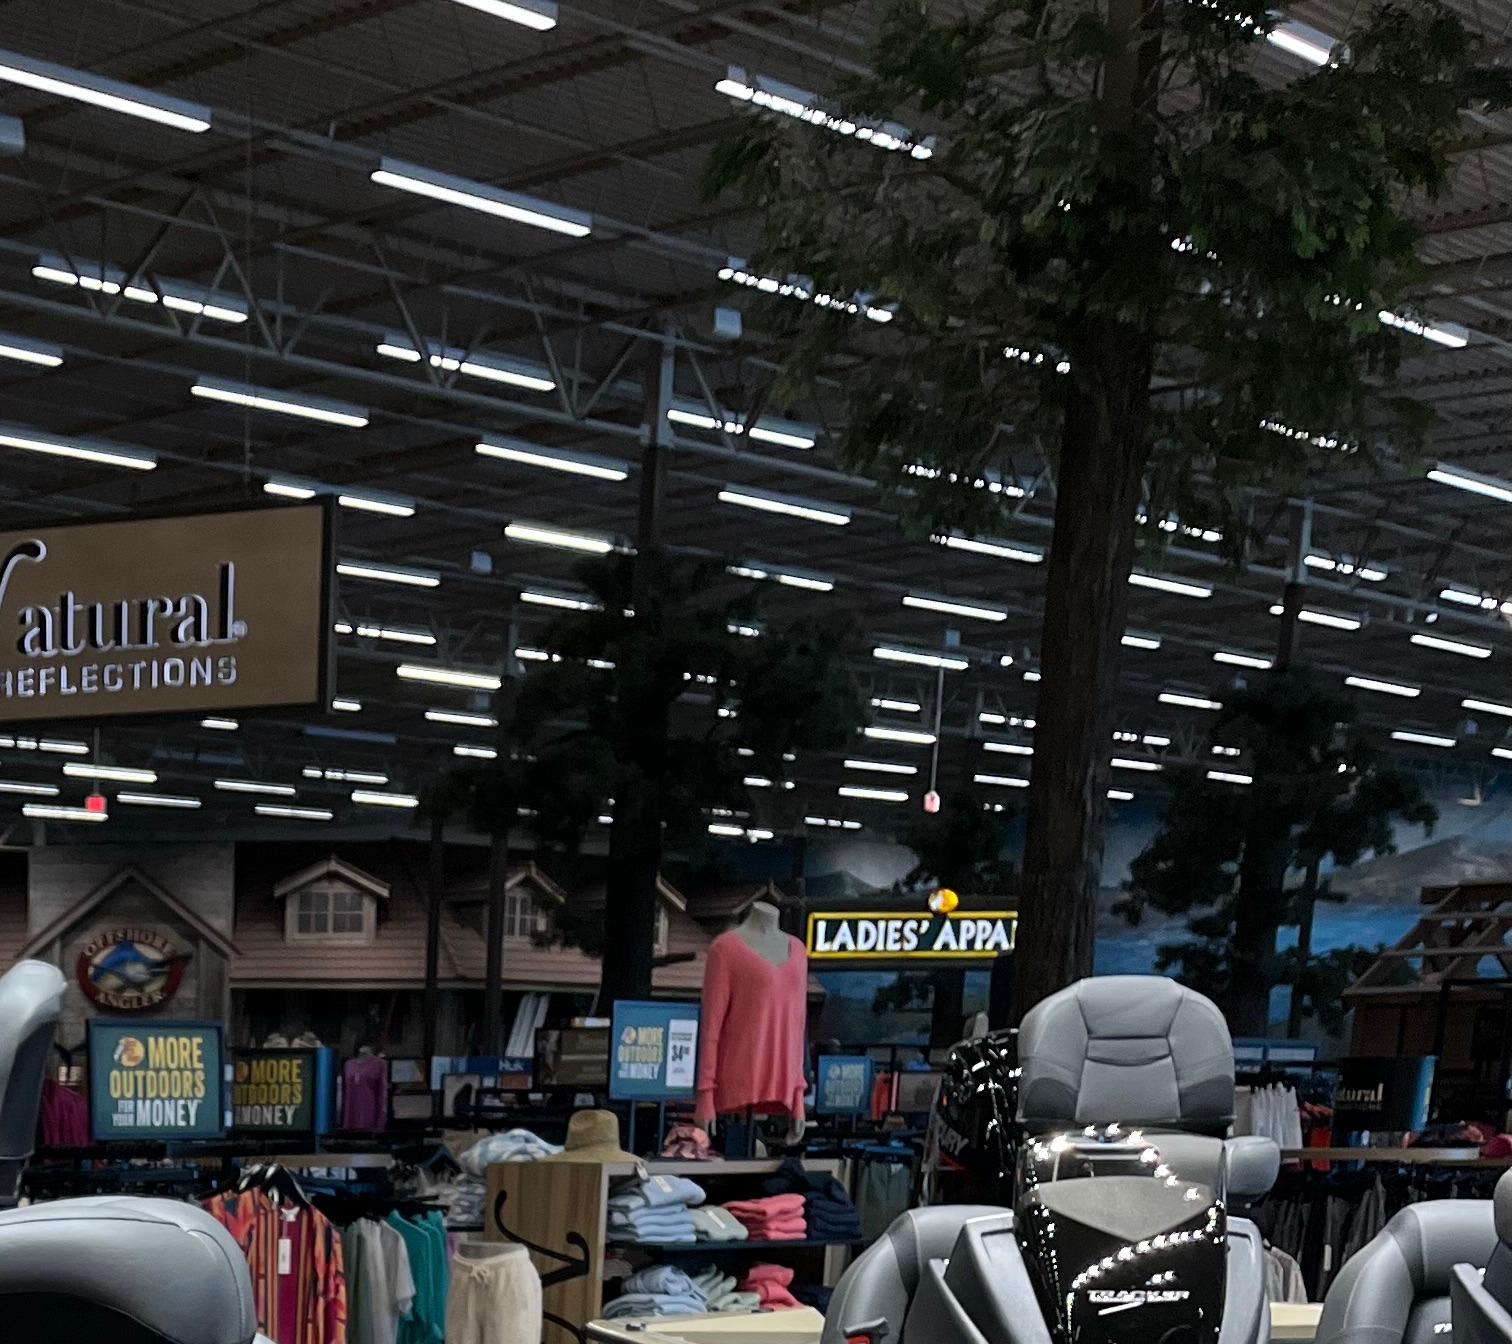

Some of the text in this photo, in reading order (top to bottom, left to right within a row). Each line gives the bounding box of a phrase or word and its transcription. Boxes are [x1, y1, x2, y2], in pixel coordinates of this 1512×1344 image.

[815, 918, 1018, 952] LADIES' APPA
[148, 1037, 204, 1069] MORE
[109, 1070, 205, 1098] OUTDOORS
[251, 1059, 302, 1083] MORE
[136, 1099, 199, 1126] MONEY
